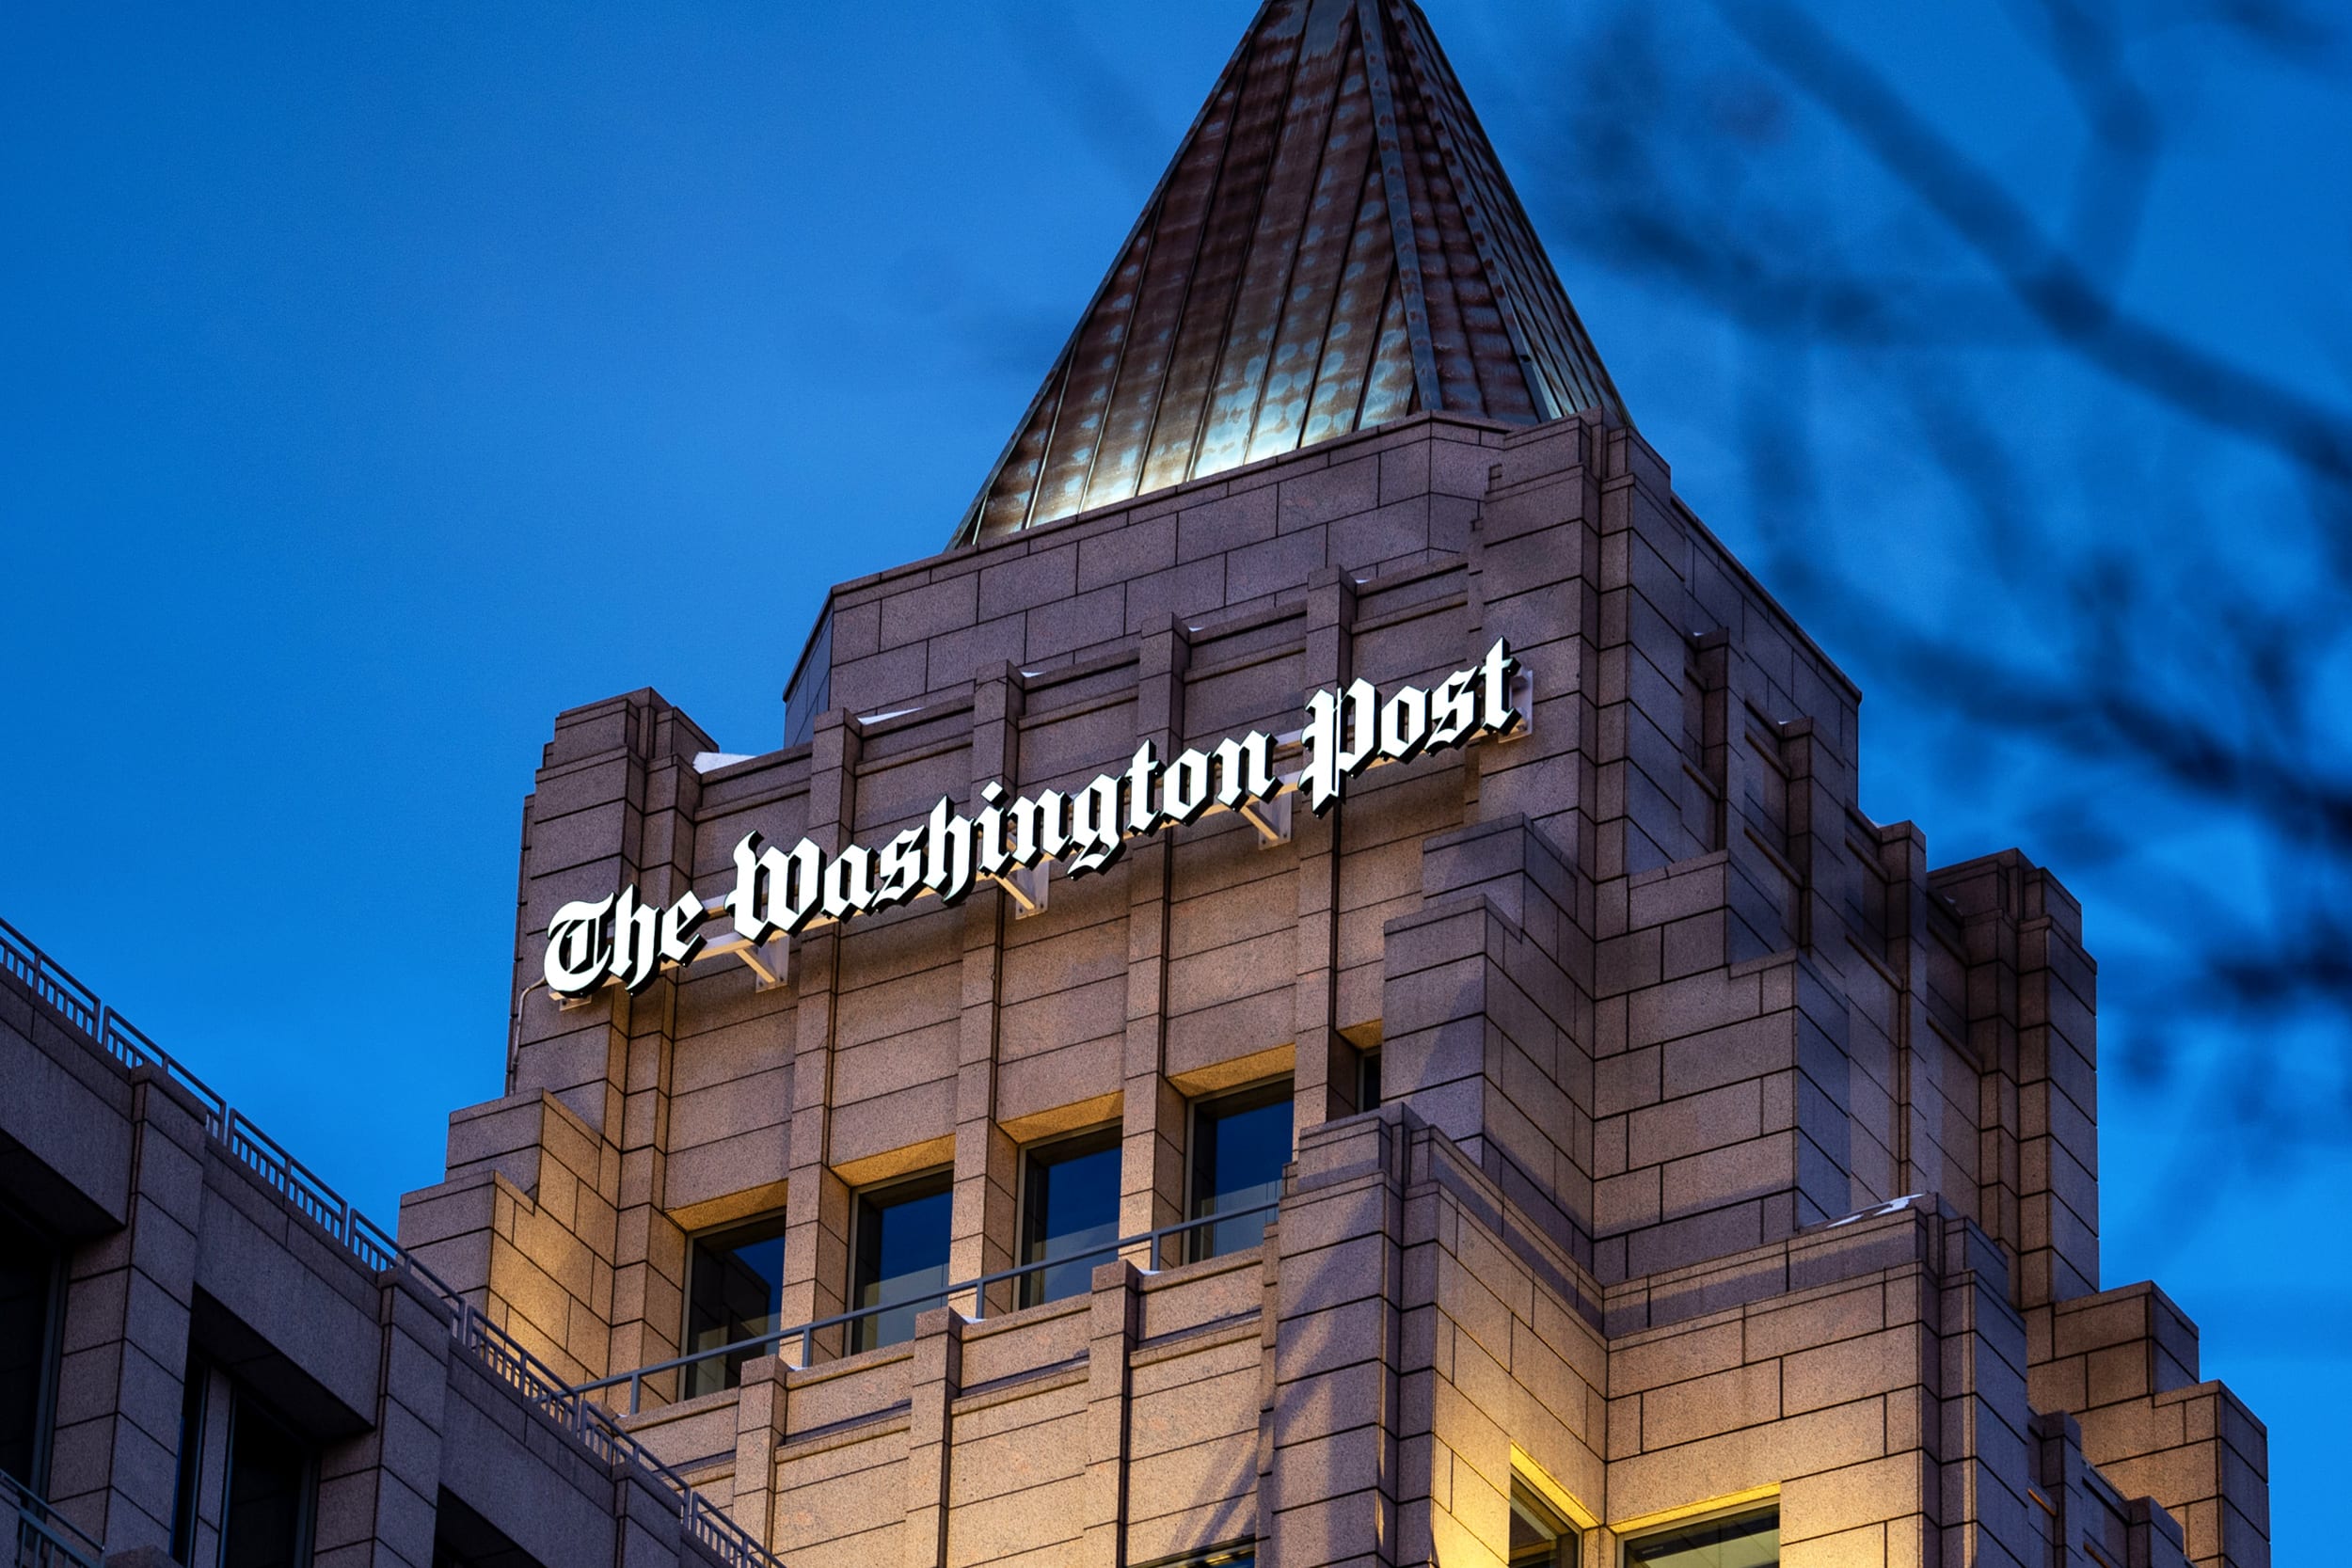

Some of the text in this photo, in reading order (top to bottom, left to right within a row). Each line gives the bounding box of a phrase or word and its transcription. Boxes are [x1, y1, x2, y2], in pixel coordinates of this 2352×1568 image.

[543, 637, 1513, 991] The Washington Post
